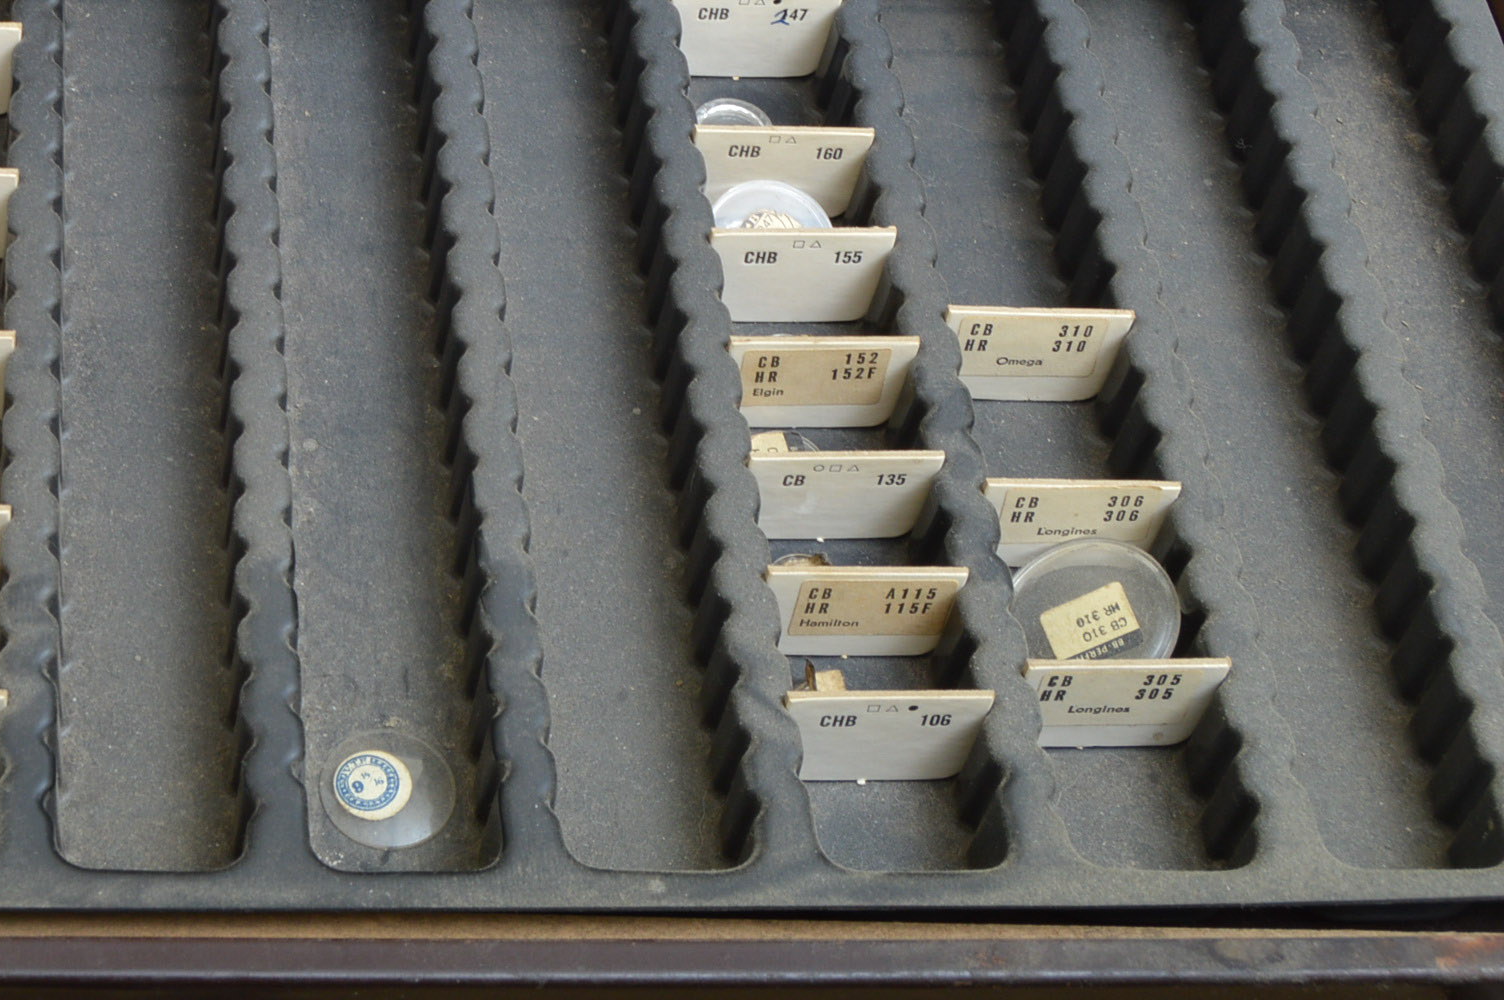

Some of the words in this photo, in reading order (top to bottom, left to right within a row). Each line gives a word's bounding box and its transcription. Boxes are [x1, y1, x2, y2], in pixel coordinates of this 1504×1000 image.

[698, 8, 729, 20] CHB
[728, 145, 761, 157] CHB
[816, 147, 843, 160] 160
[744, 251, 778, 264] CHB
[833, 251, 863, 264] 155
[970, 324, 993, 336] CB
[1059, 325, 1093, 337] 310
[964, 340, 988, 351] HR
[1052, 340, 1086, 352] 310
[758, 356, 780, 368] CB
[845, 353, 878, 365] 152
[996, 357, 1043, 366] Omega
[755, 371, 778, 383] HR
[832, 368, 877, 381] 152F
[753, 388, 784, 397] Elgin
[783, 475, 806, 486] CB
[876, 474, 907, 485] 135
[1015, 496, 1039, 508] CB
[1108, 495, 1144, 507] 306
[1010, 511, 1035, 523] HR
[1103, 510, 1139, 522] 306
[1037, 527, 1097, 536] Longines
[808, 588, 832, 599] CB
[886, 588, 937, 600] A115
[804, 603, 829, 614] HR
[884, 603, 933, 615] 115F
[799, 618, 859, 627] Hamilton
[1048, 676, 1072, 687] CB
[1144, 674, 1182, 686] 305
[1135, 689, 1173, 700] 305
[1068, 706, 1130, 714] Longines
[819, 715, 857, 727] CHB
[920, 714, 952, 726] 106
